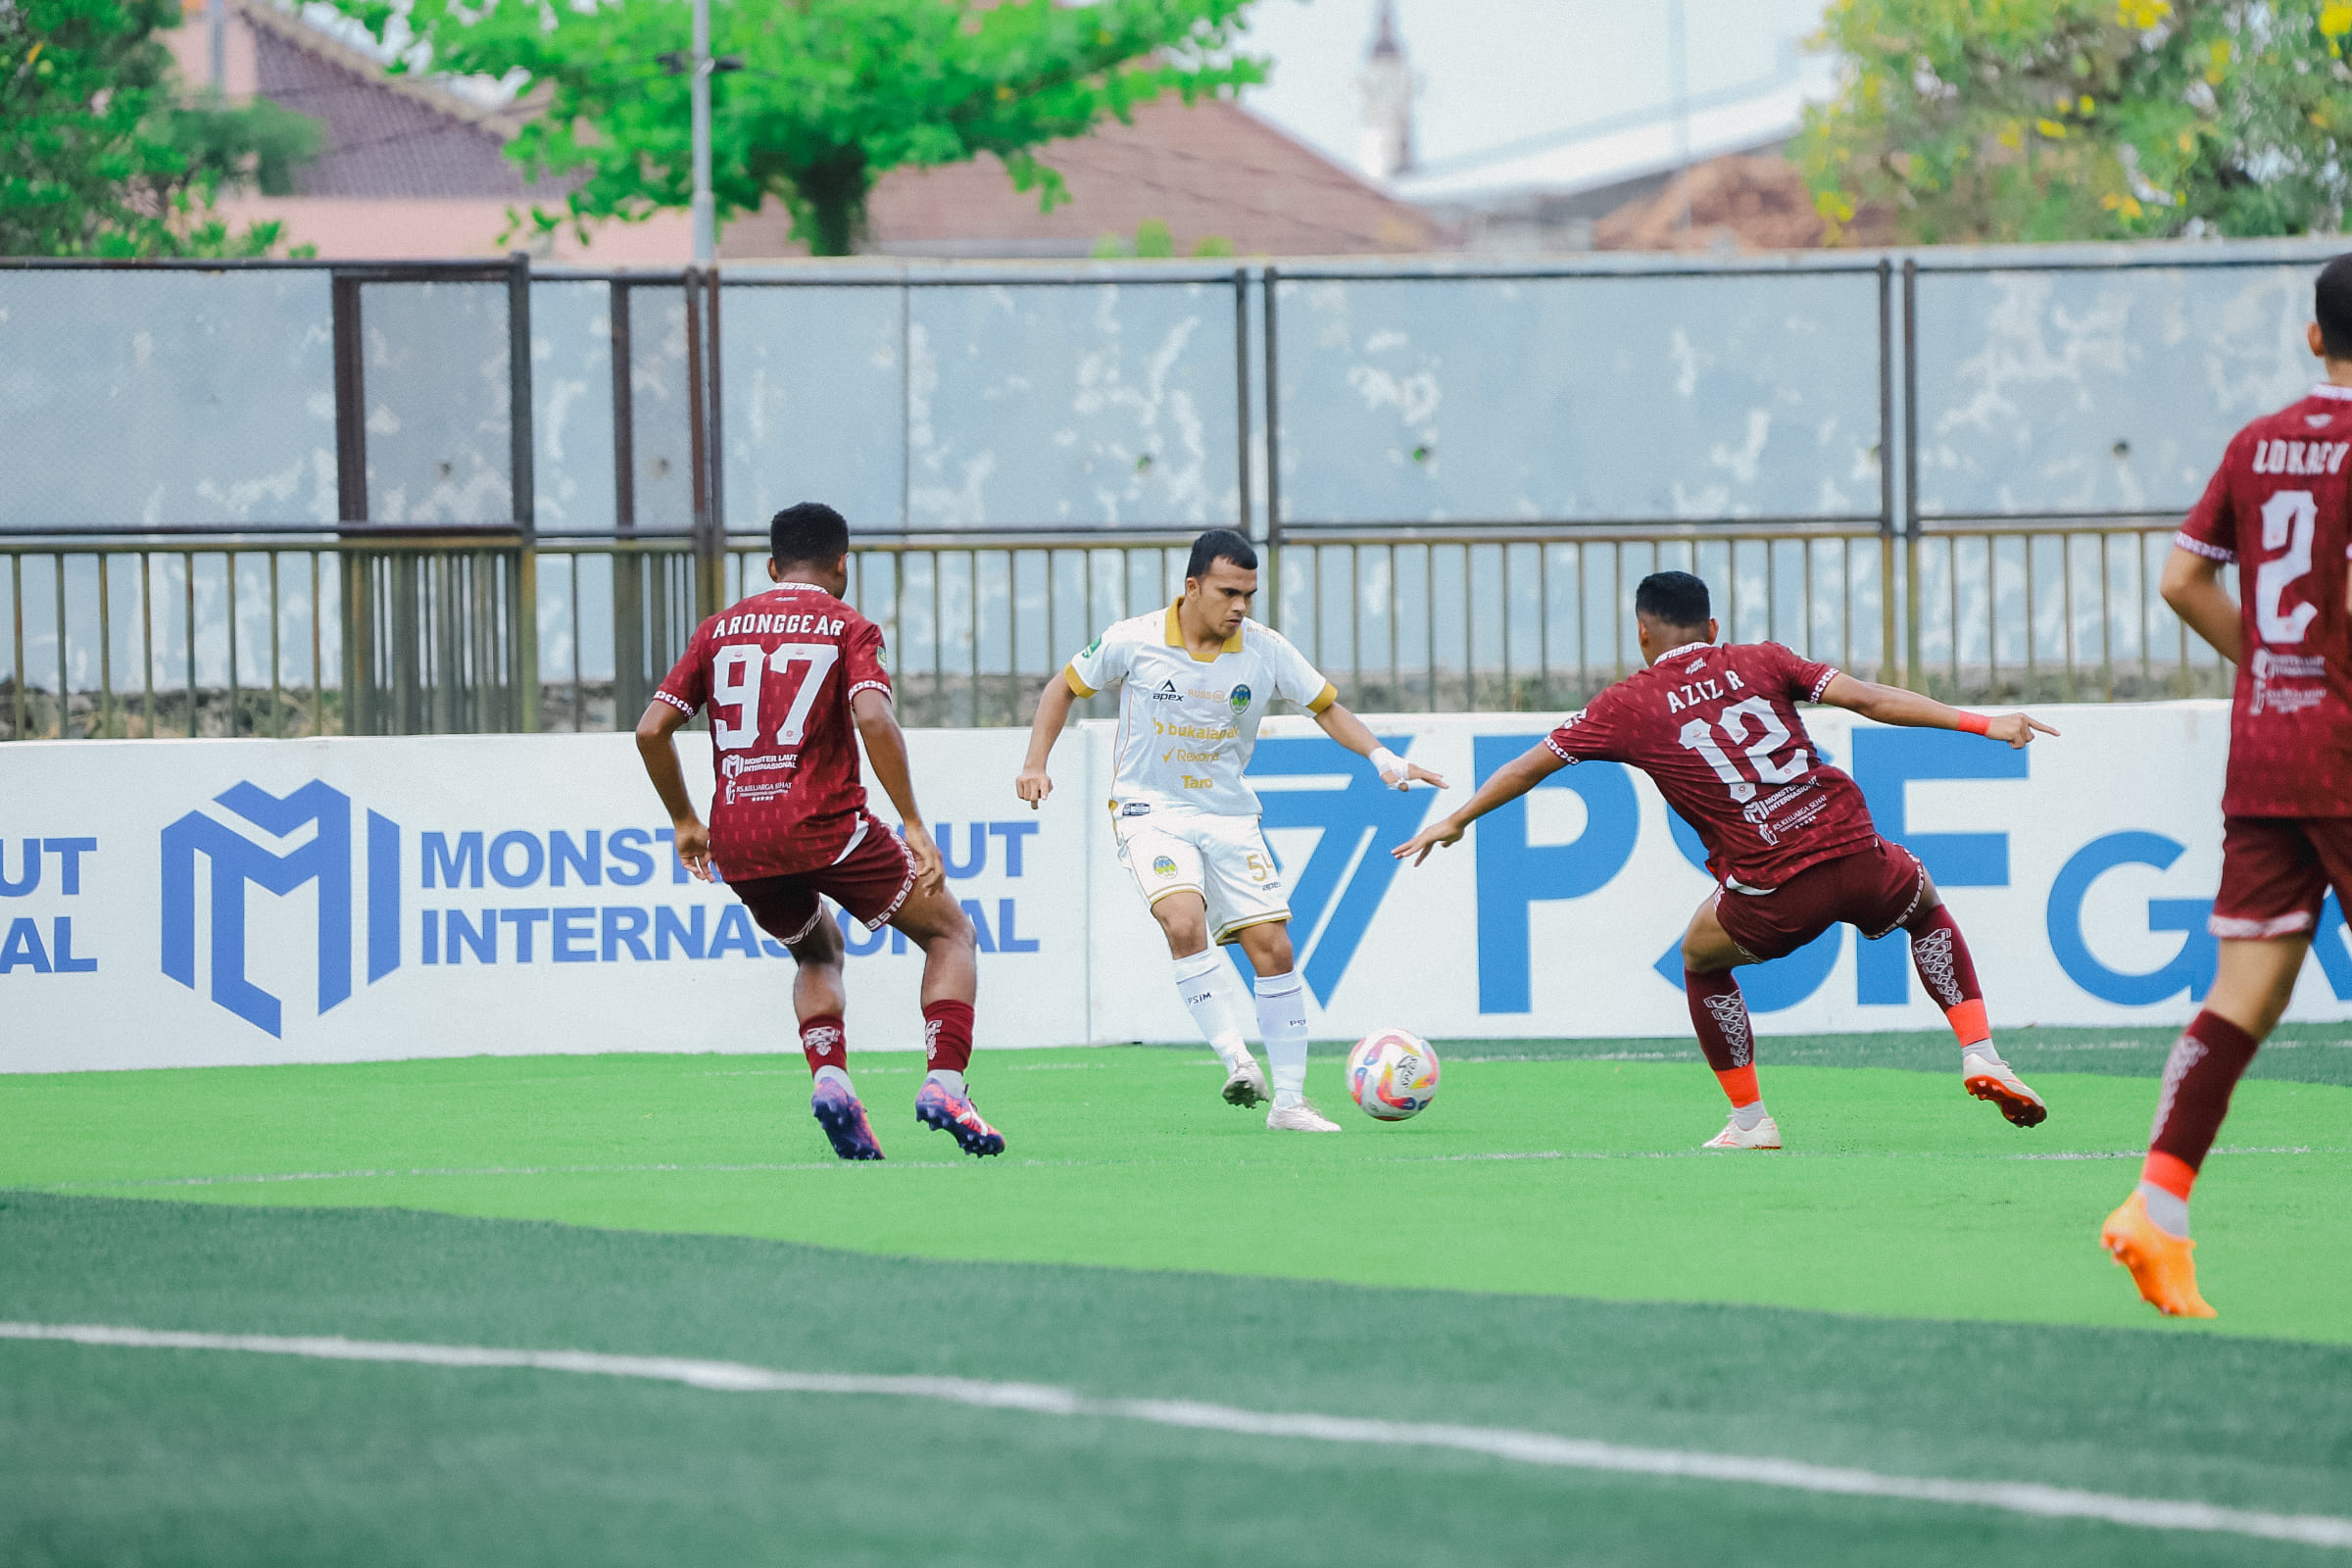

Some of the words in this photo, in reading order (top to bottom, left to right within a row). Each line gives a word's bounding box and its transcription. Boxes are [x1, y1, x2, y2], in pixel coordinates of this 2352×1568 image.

[2256, 491, 2319, 644] 2
[711, 612, 846, 640] ARONGGEAR
[711, 642, 840, 752] 97
[1152, 692, 1184, 703] apex
[1666, 678, 1724, 714] AZIZ
[1724, 669, 1745, 691] R
[1168, 722, 1240, 742] bukalapak
[1678, 695, 1809, 804] 12
[1181, 774, 1213, 789] Taro
[1764, 784, 1801, 806] MONSTE
[421, 828, 698, 888] MONST
[1188, 991, 1211, 1004] PSIM
